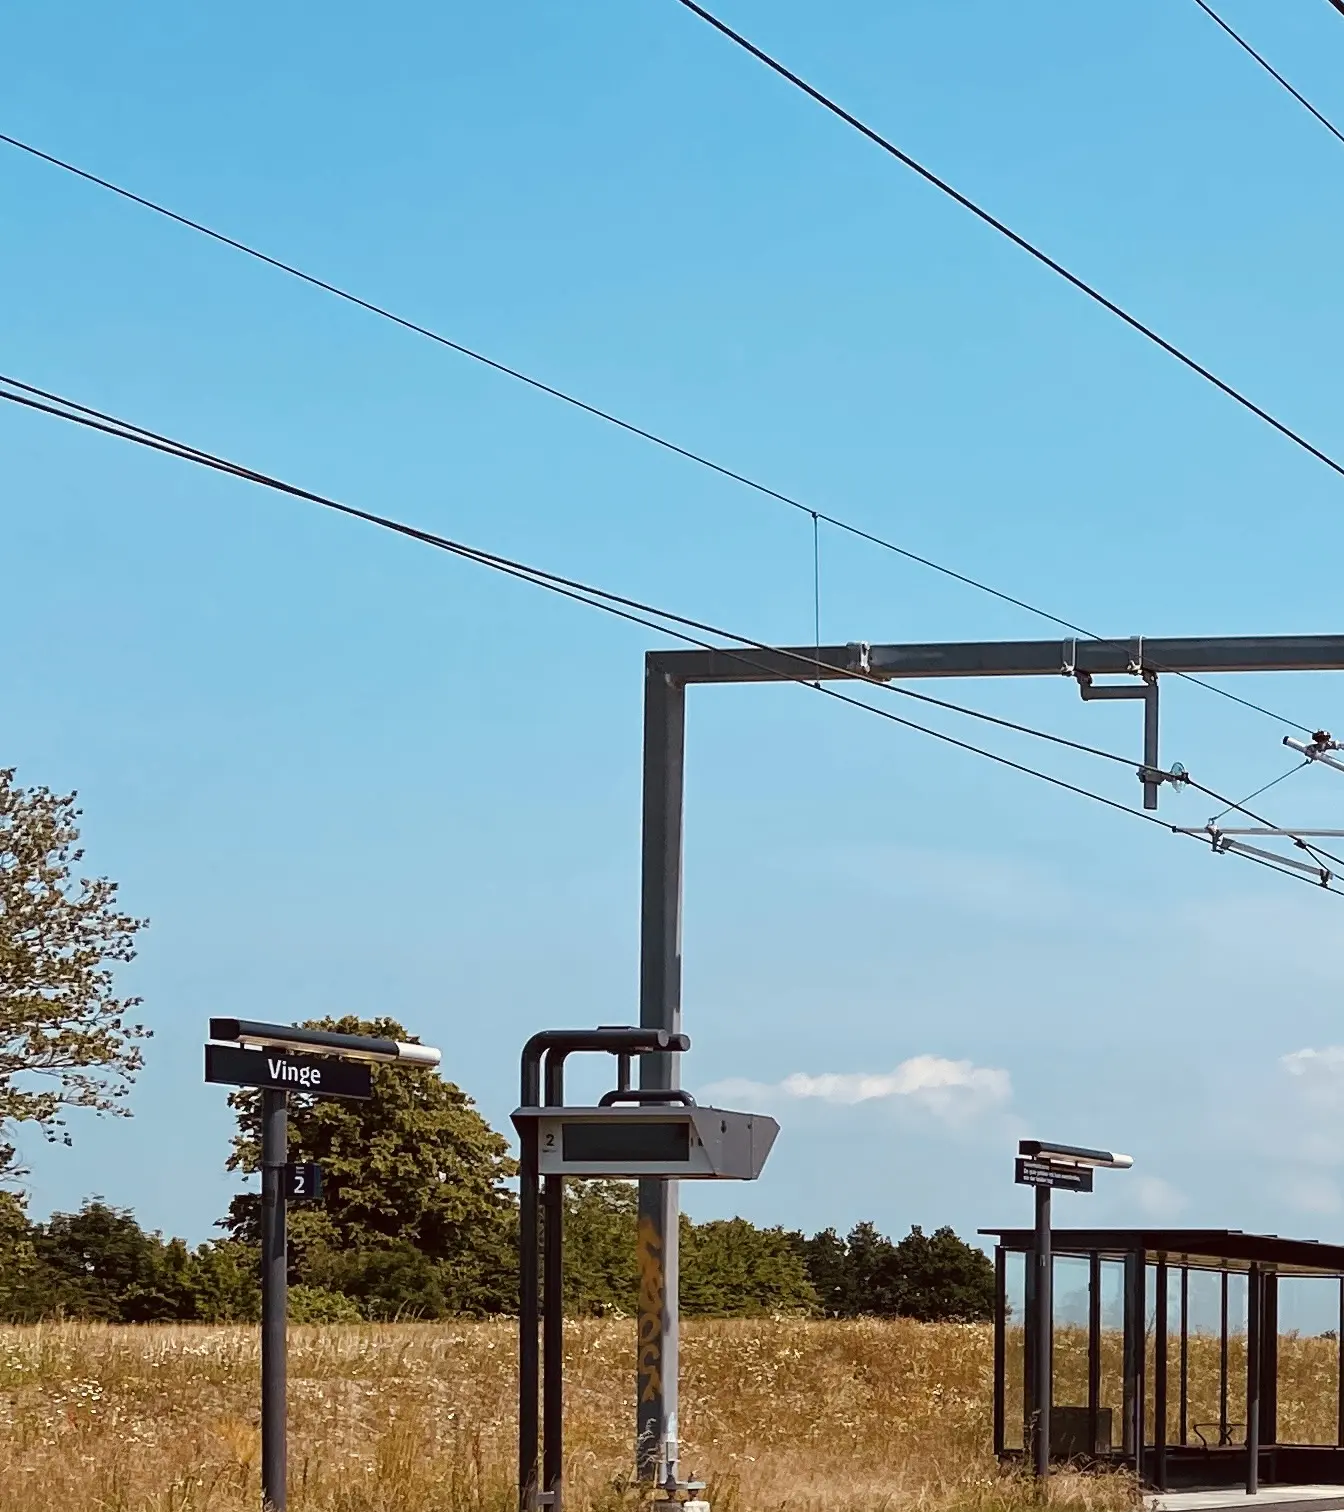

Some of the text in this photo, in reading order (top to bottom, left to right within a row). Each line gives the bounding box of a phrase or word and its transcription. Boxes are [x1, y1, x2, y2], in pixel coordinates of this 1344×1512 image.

[267, 1058, 322, 1088] Vinge
[545, 1133, 555, 1147] 2
[294, 1176, 305, 1194] 2
